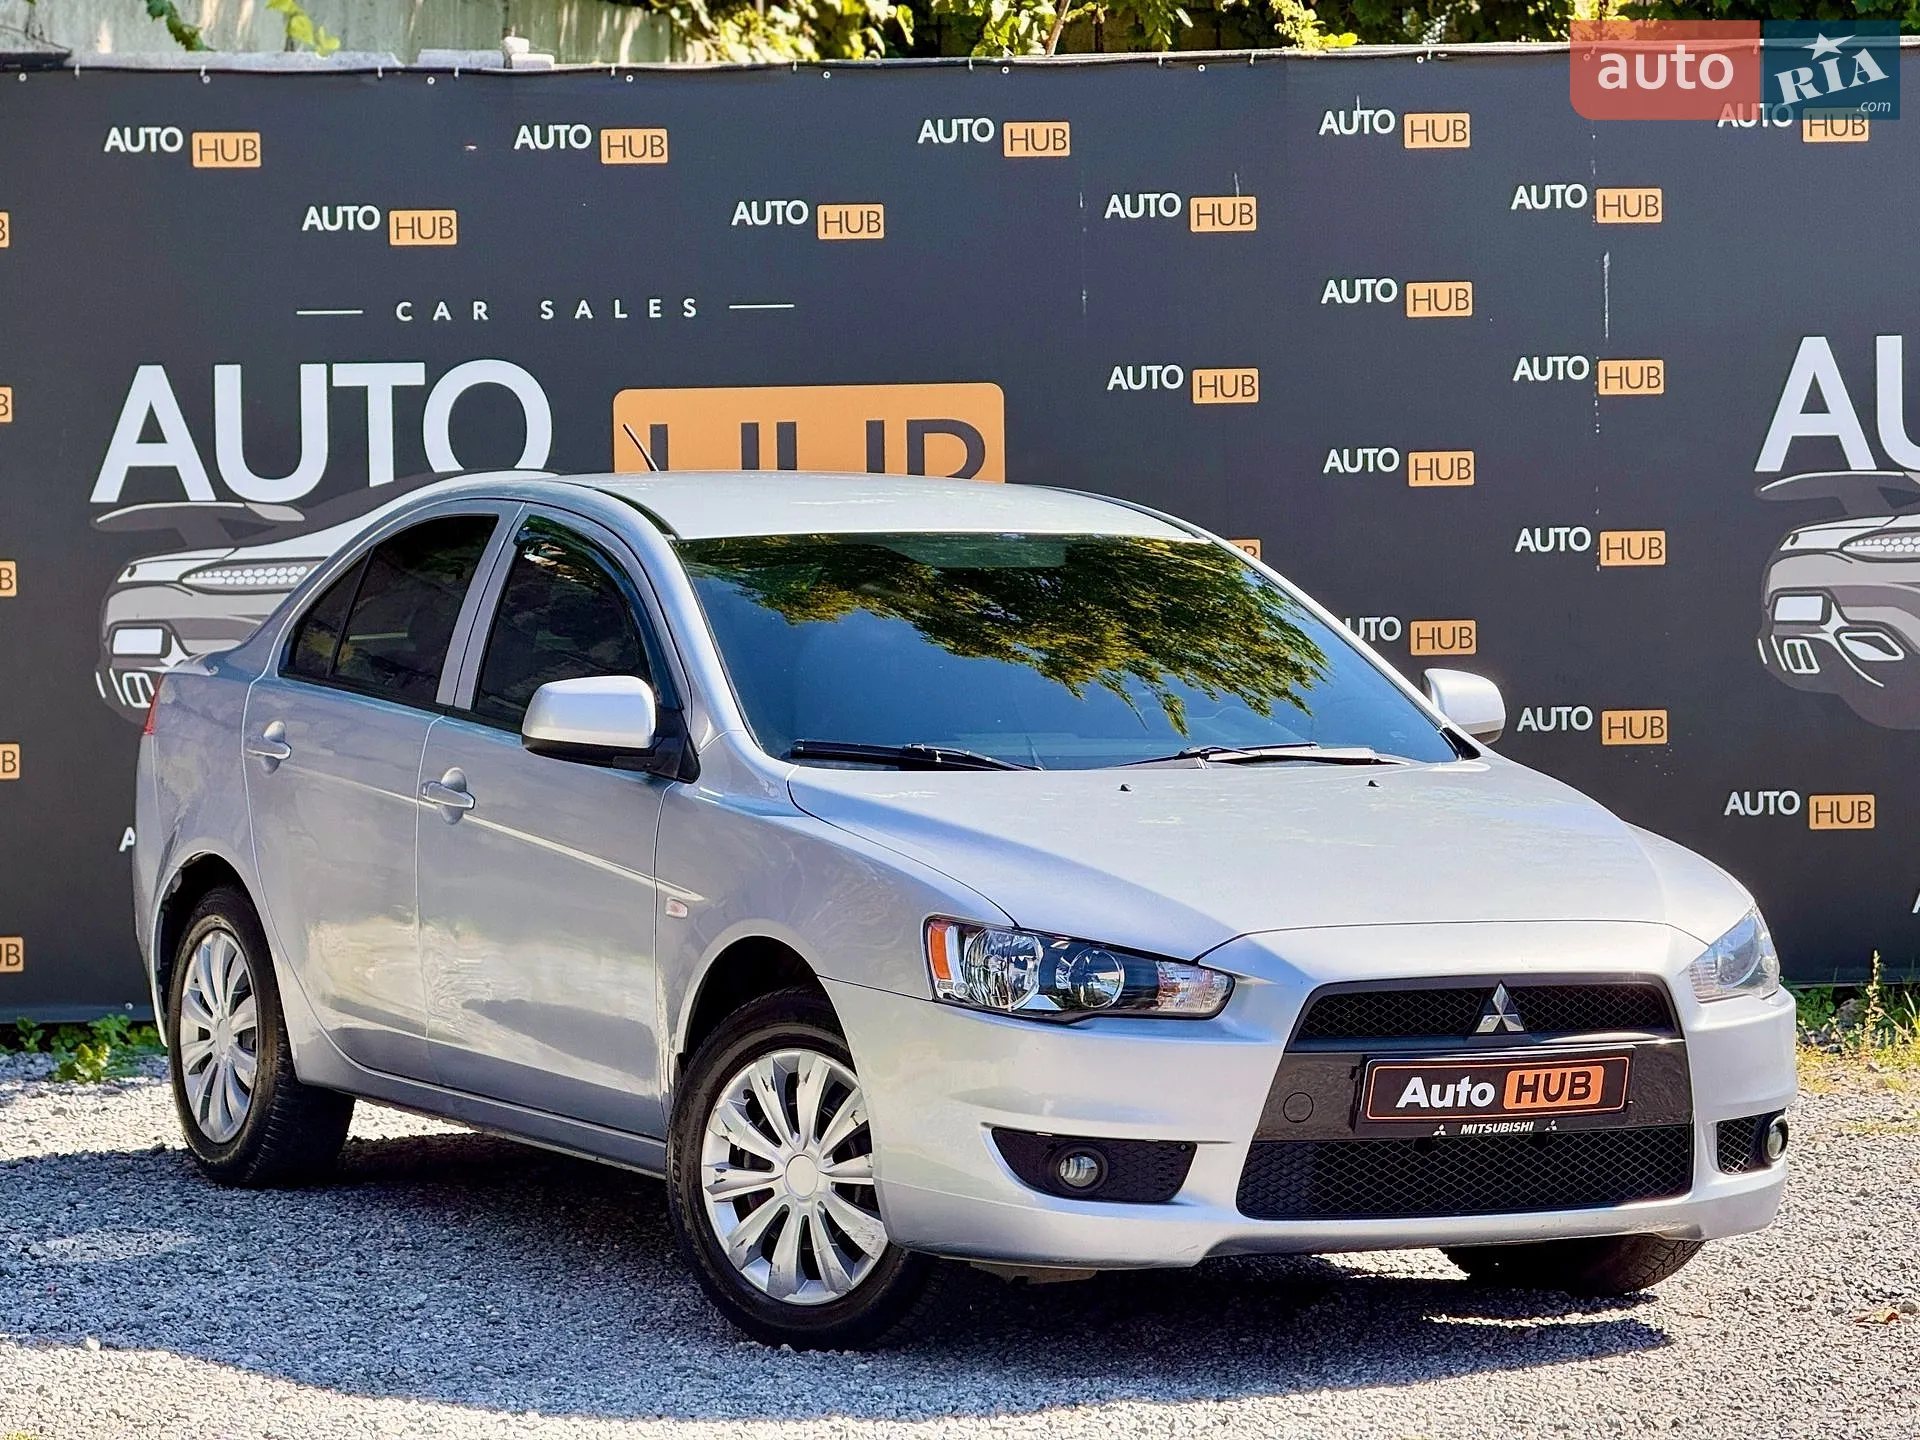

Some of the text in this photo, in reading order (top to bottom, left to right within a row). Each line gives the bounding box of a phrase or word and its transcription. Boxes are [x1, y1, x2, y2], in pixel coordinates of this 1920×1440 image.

[917, 118, 1066, 152] AUTO HUB
[1318, 110, 1466, 143] AUTO HUB
[1717, 103, 1866, 137] AUTO HUB
[103, 127, 257, 162] AUTO HUB
[513, 124, 665, 159] AUTO HUB
[731, 200, 881, 235] AUTO HUB
[1104, 193, 1253, 227] AUTO HUB
[1510, 184, 1659, 218] AUTO HUB
[302, 206, 454, 240] AUTO HUB
[395, 298, 697, 321] CAR SALES
[1320, 278, 1469, 312] AUTO HUB
[1106, 365, 1255, 399] AUTO HUB
[1512, 356, 1661, 390] AUTO HUB
[89, 359, 553, 503] AUTO
[1322, 448, 1471, 482] AUTO HUB
[1514, 527, 1662, 561] AUTO HUB
[1416, 626, 1473, 651] HUB
[1516, 706, 1665, 740] AUTO HUB
[1724, 790, 1872, 825] AUTO HUB
[1395, 1070, 1592, 1109] Auto HUB
[1459, 1121, 1535, 1135] MITSUBISHI
